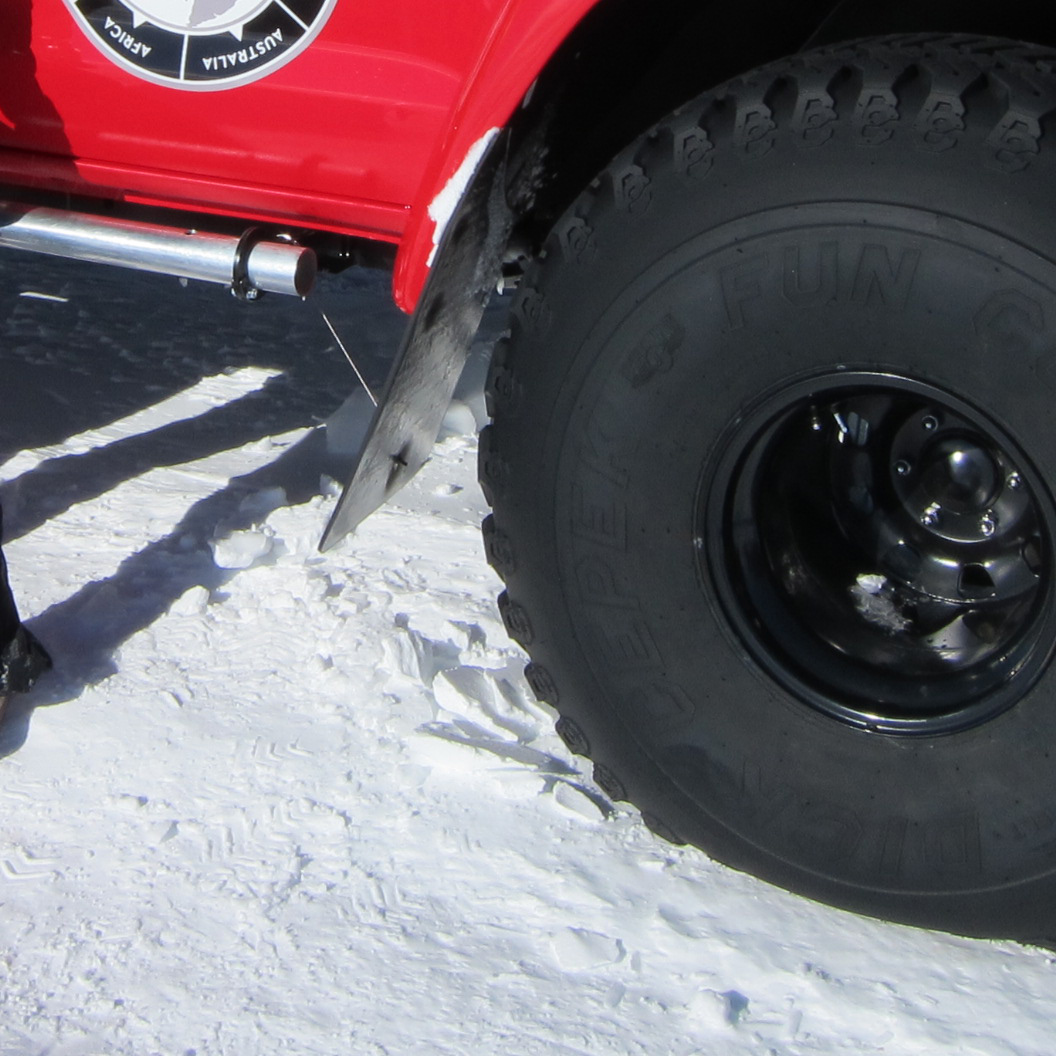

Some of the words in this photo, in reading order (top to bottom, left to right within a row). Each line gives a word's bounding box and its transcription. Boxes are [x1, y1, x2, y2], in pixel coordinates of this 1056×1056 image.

[105, 16, 152, 59] AFRICA
[202, 28, 284, 71] AUSTRALIA
[720, 241, 921, 331] FUN
